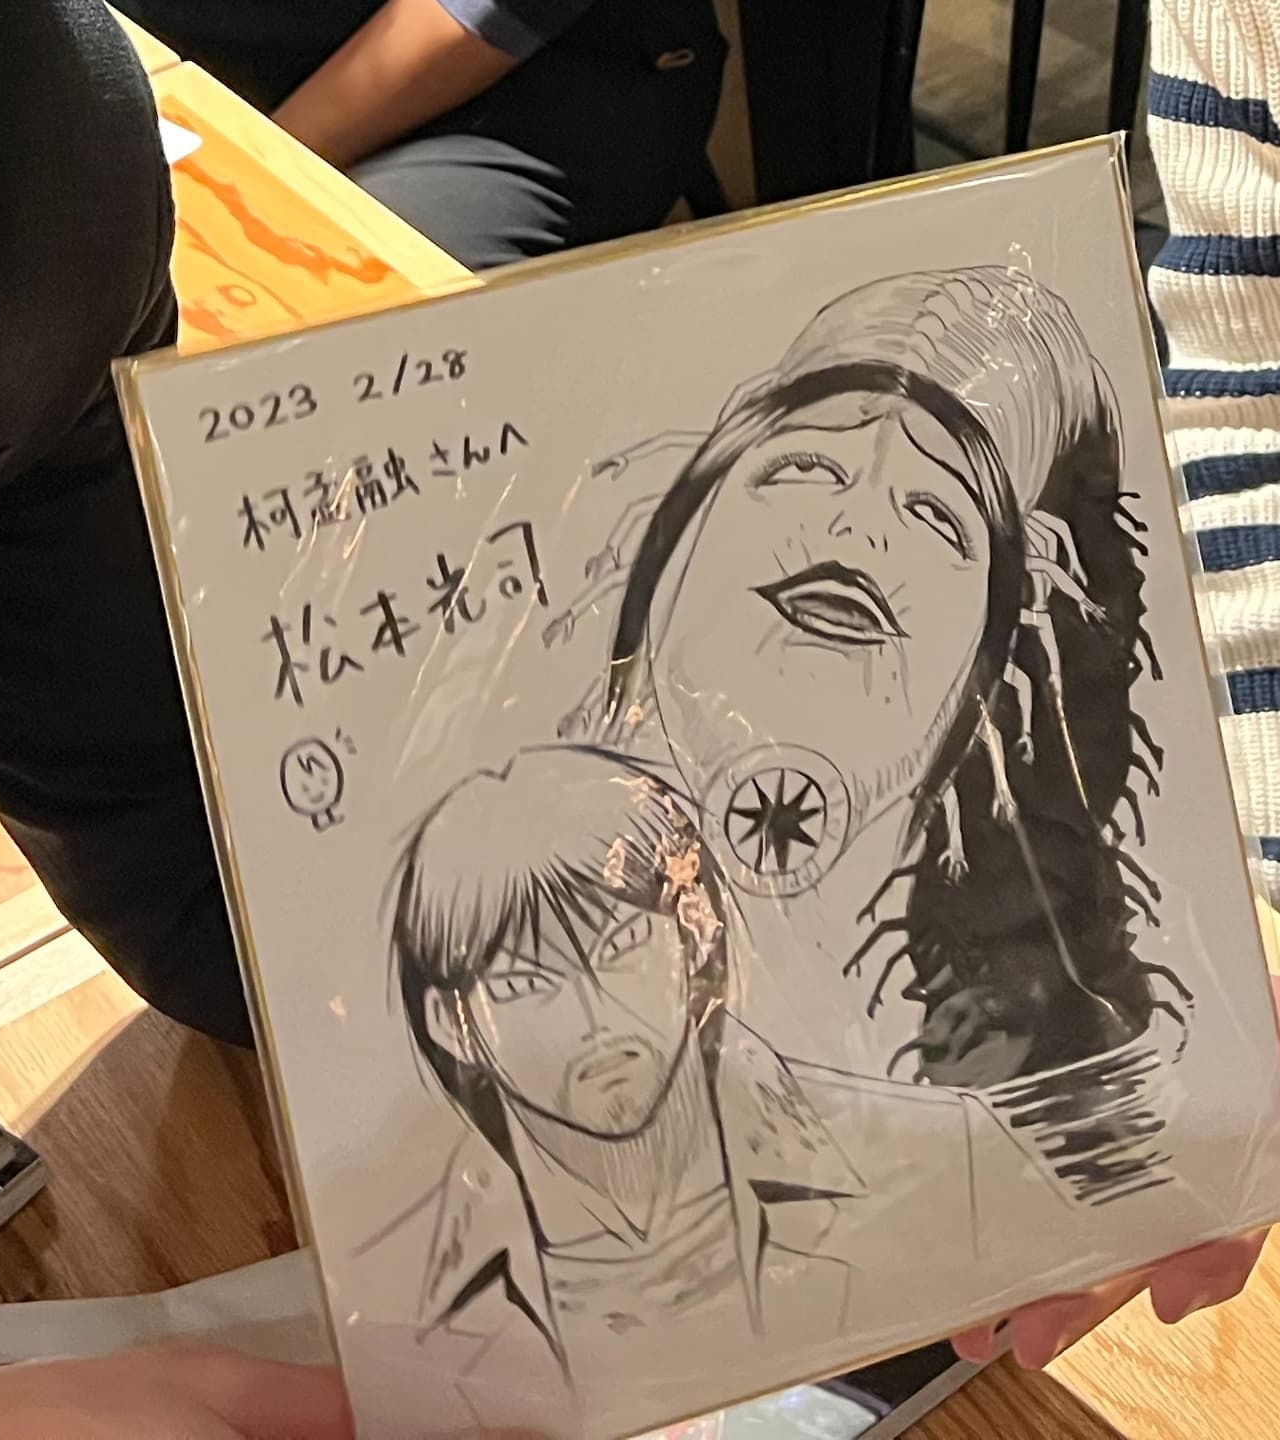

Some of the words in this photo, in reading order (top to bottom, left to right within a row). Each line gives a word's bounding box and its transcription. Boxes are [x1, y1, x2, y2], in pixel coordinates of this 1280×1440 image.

[198, 383, 318, 444] 2023
[353, 349, 468, 404] 2/28
[261, 520, 549, 708] 松本光司
